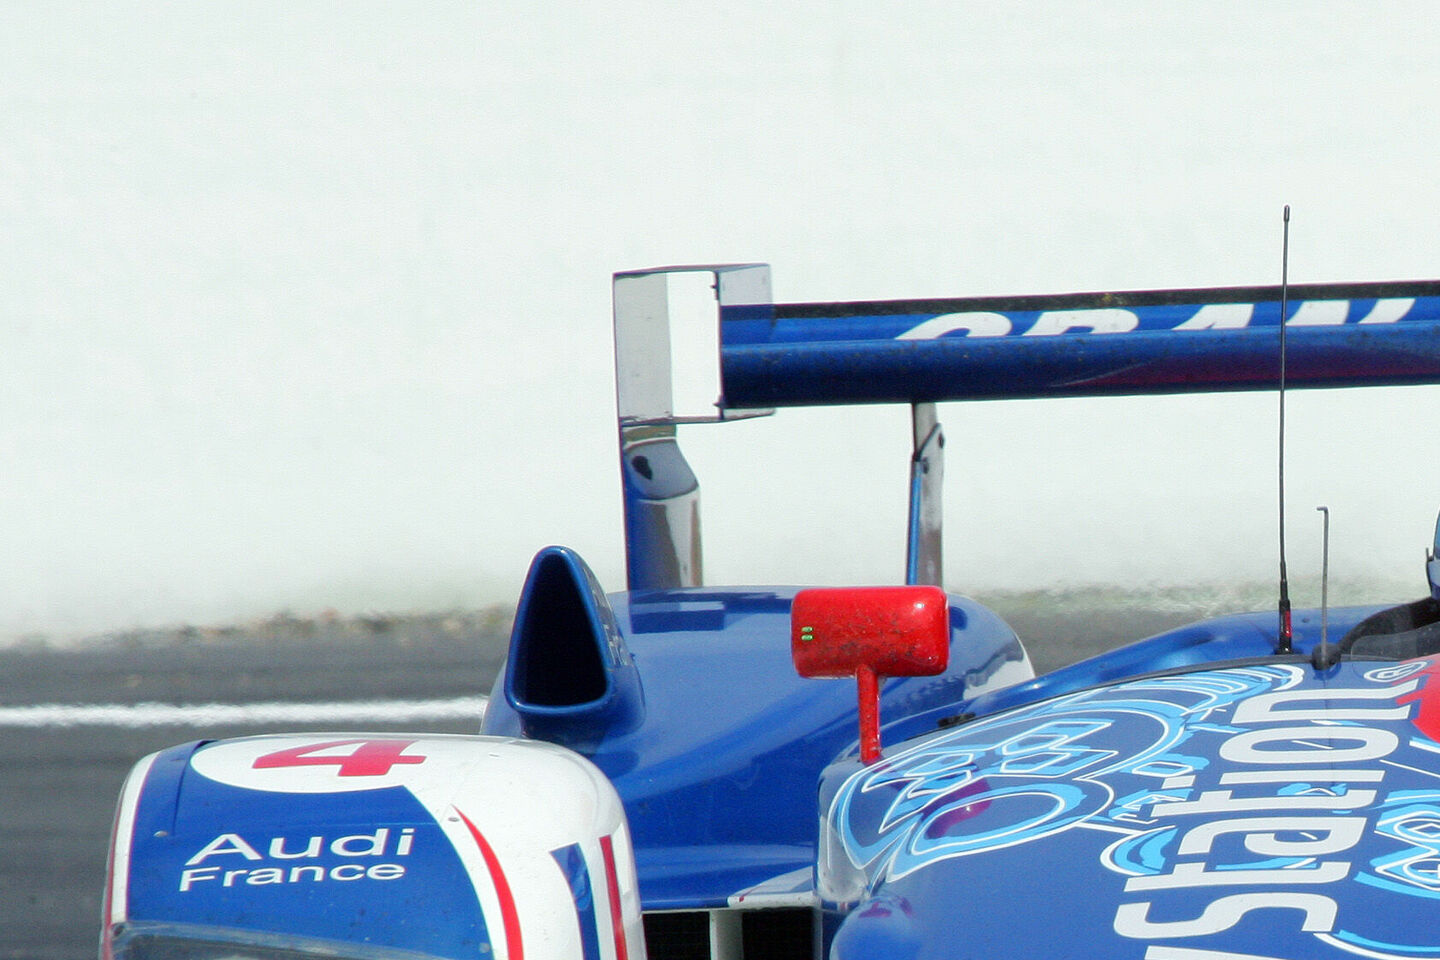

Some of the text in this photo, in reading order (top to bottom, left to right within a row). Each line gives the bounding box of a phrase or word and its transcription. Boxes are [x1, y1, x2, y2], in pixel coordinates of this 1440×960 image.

[252, 740, 426, 777] 4
[185, 828, 415, 866] Audi
[180, 861, 405, 891] France
